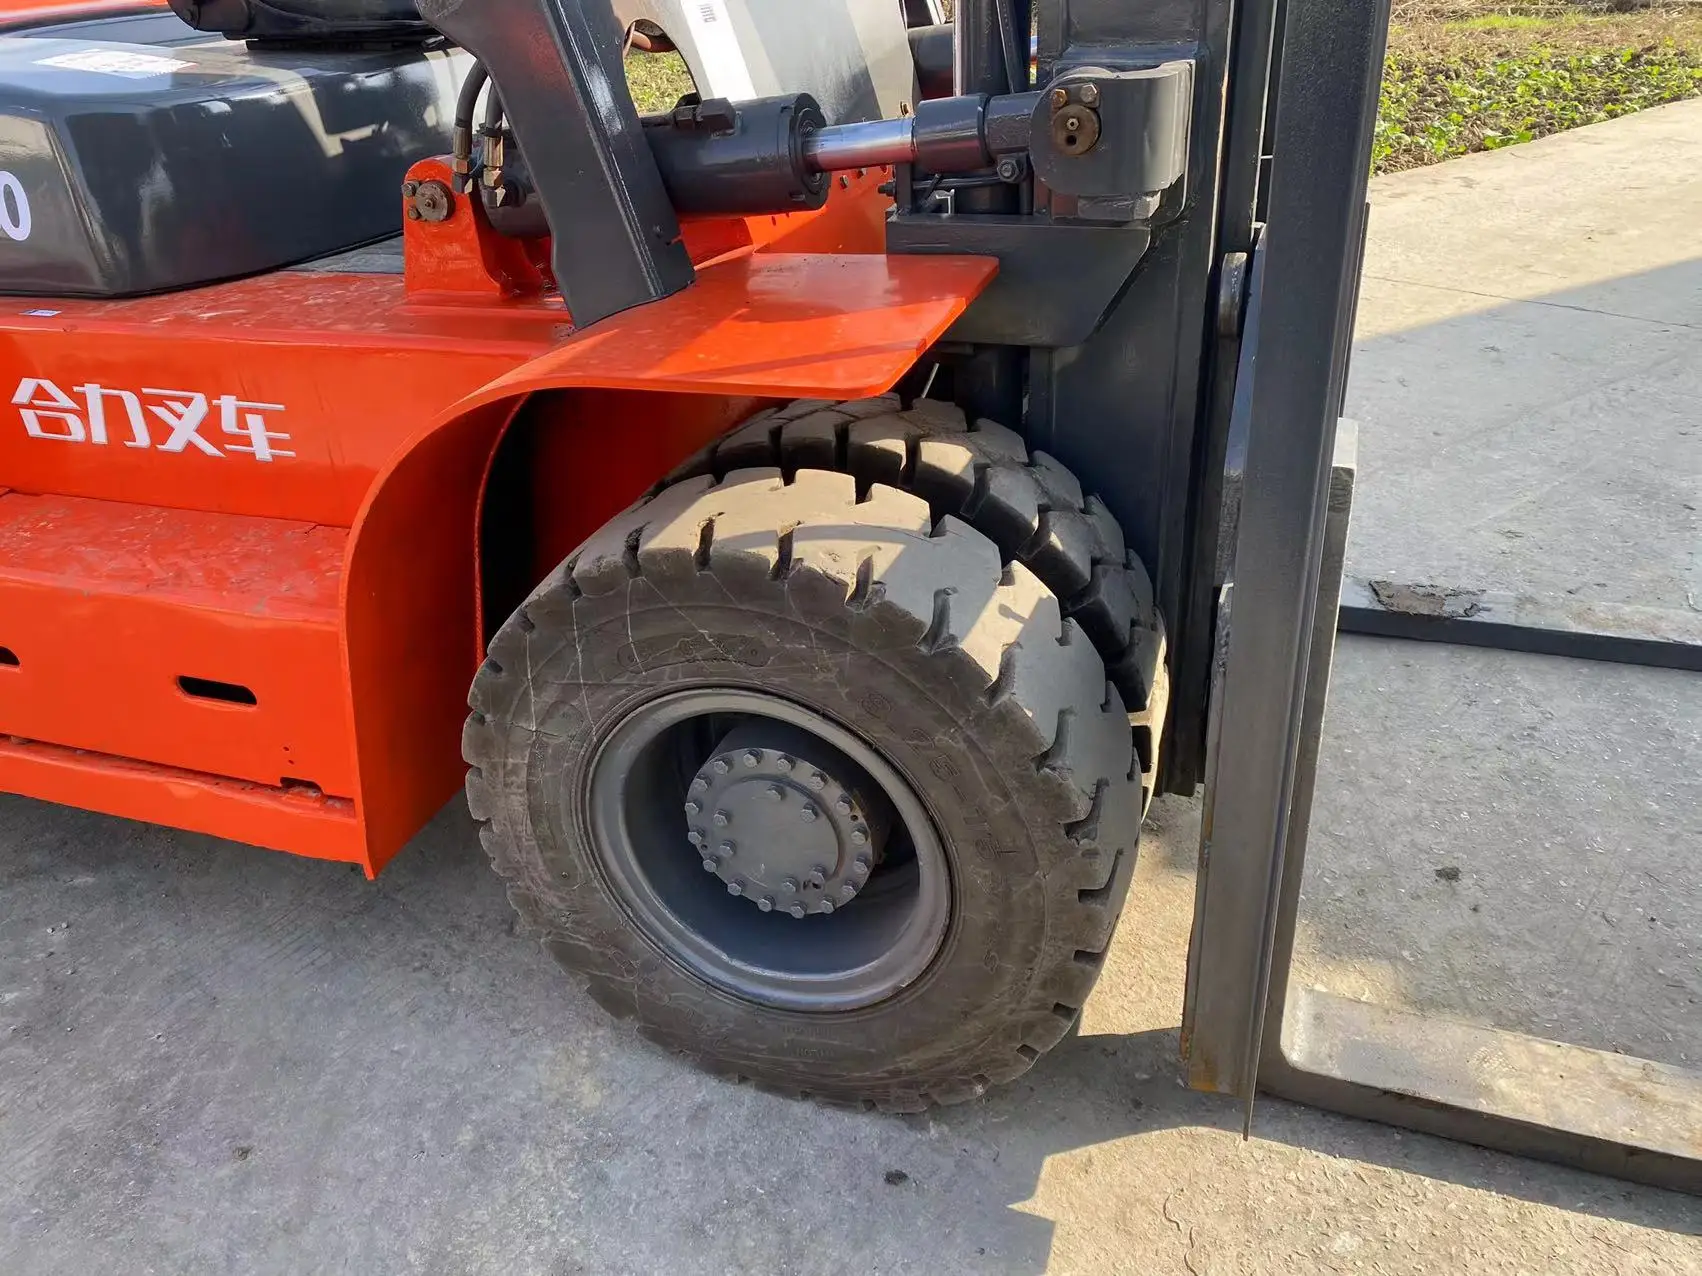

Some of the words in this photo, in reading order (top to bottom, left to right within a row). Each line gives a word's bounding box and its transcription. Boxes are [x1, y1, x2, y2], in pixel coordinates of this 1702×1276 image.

[0, 170, 31, 241] 0
[11, 377, 296, 462] 合力叉车
